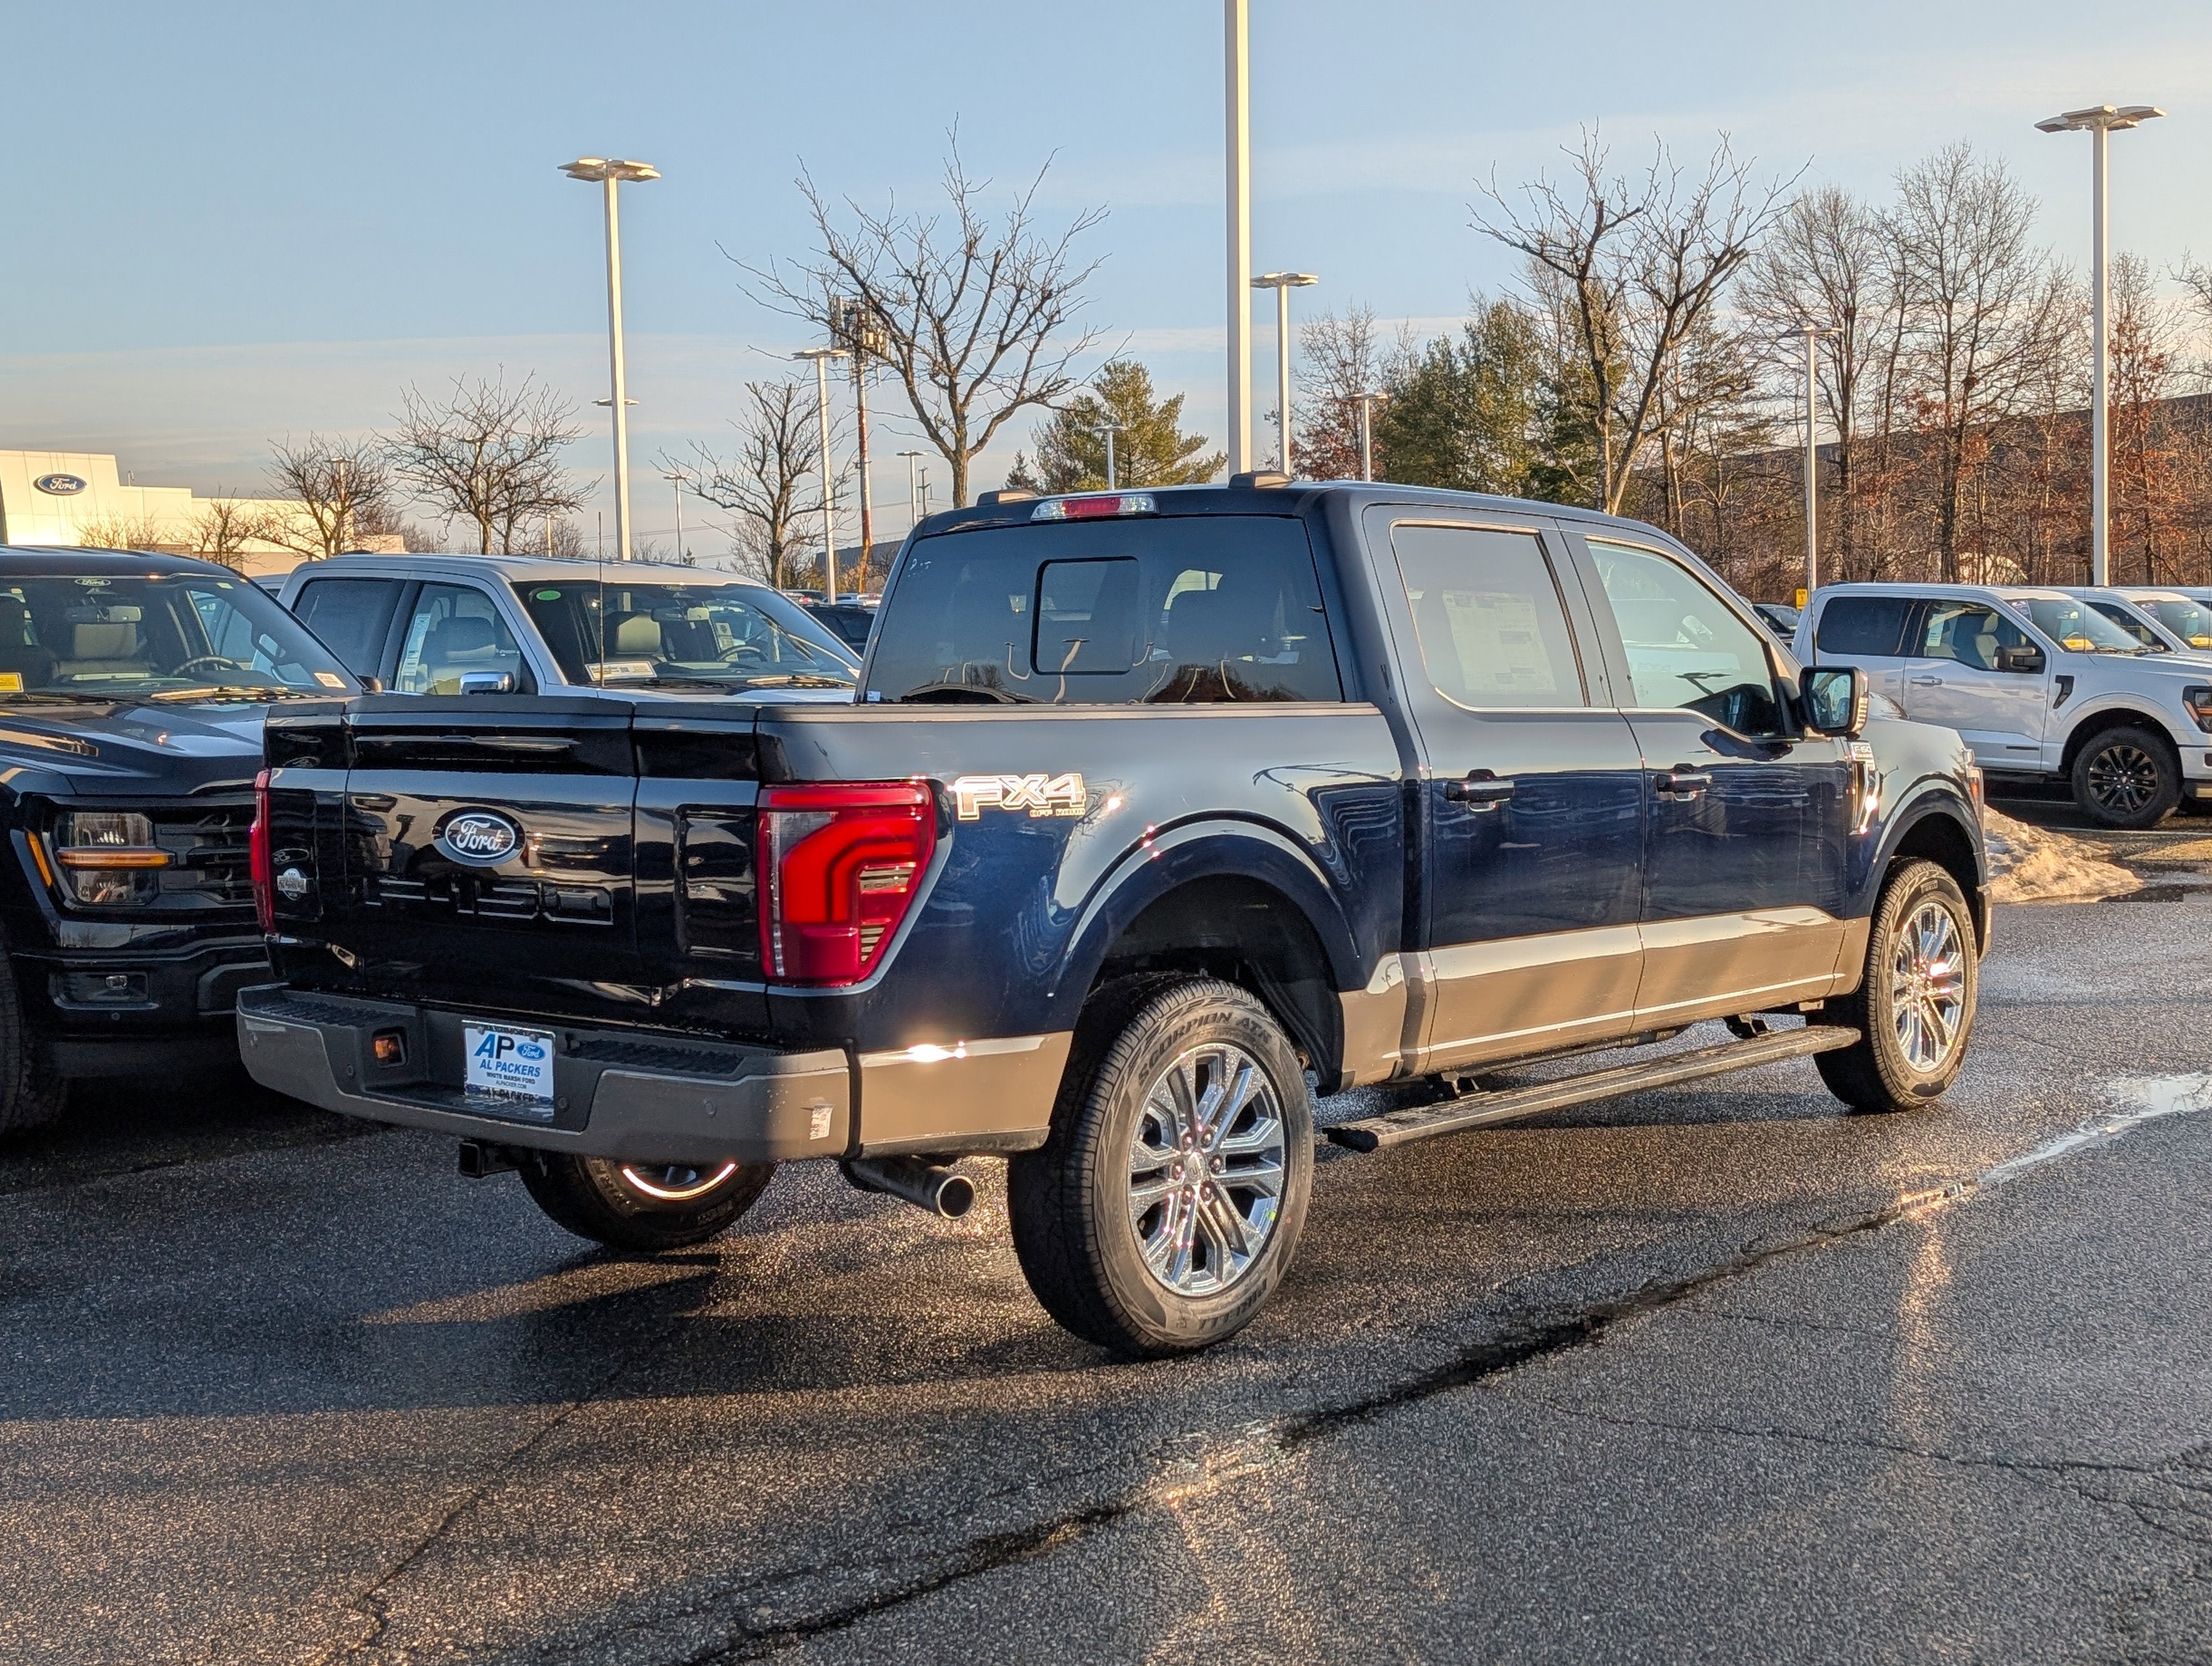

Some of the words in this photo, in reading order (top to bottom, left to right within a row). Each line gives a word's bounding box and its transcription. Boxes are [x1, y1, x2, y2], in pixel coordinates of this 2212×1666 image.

[49, 478, 78, 490] Ford
[954, 773, 1086, 821] FX4
[456, 819, 504, 851] Ford
[473, 1033, 515, 1059] AP
[522, 1044, 541, 1058] Ford
[1139, 1011, 1233, 1080] SCORPION
[479, 1059, 492, 1070] AL
[495, 1061, 541, 1078] PACKERS
[522, 1077, 536, 1085] FORD
